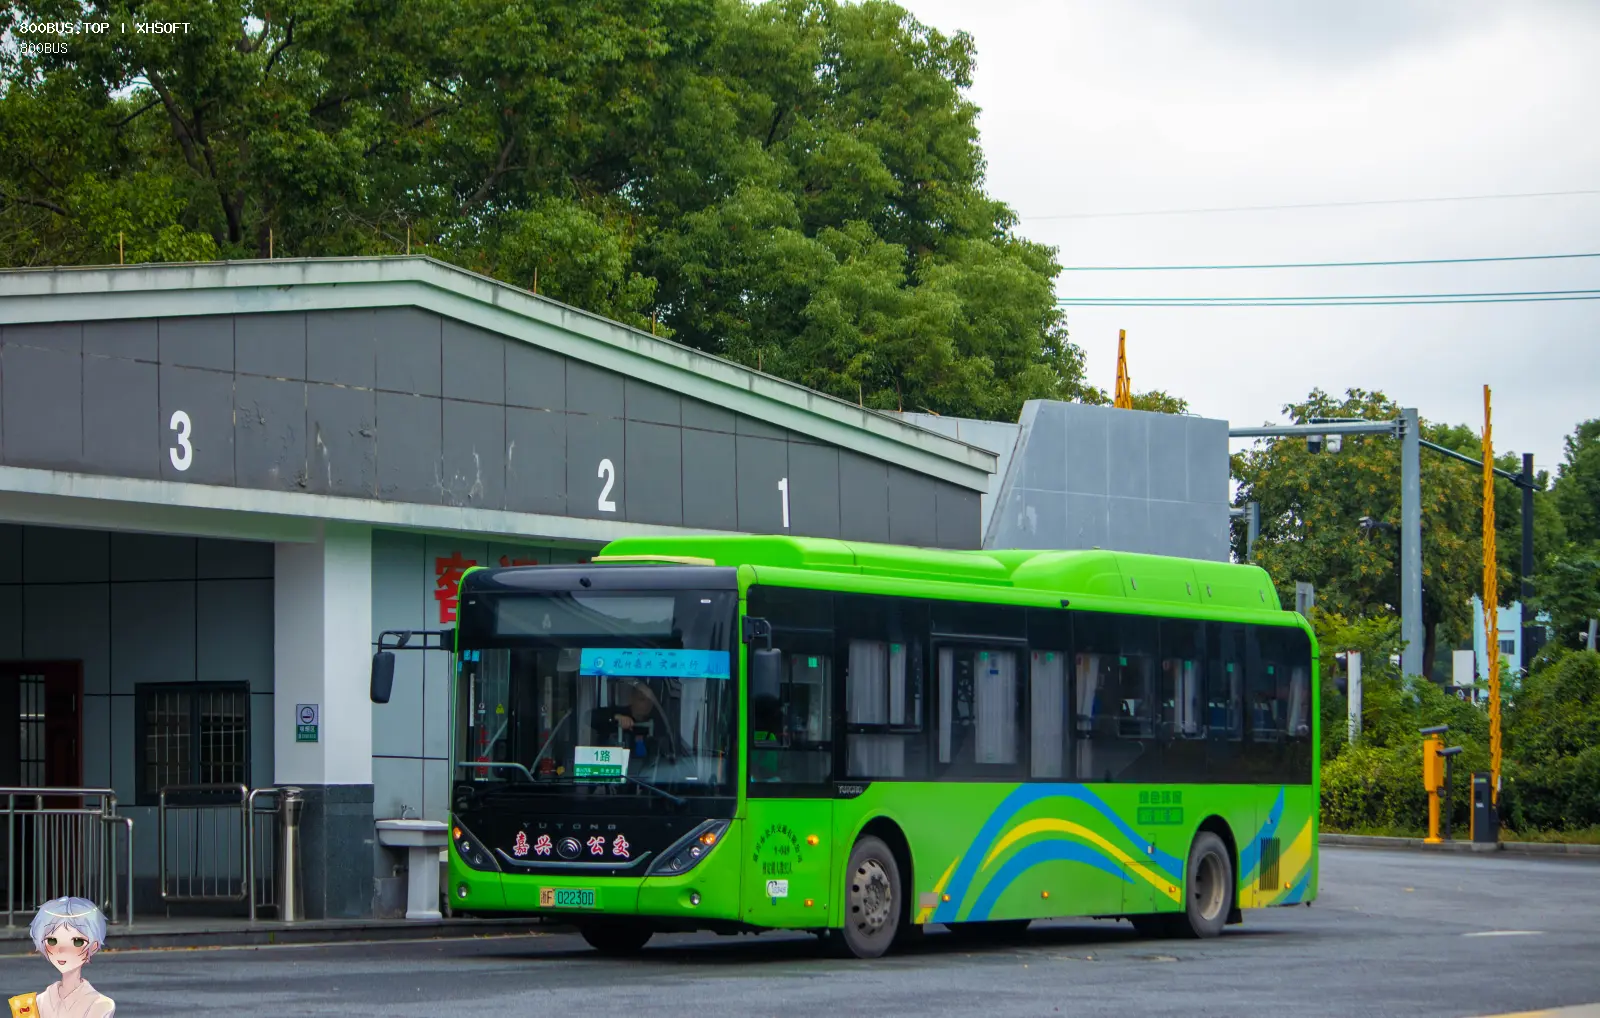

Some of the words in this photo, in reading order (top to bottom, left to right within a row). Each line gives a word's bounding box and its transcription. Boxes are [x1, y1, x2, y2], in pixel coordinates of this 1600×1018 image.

[169, 409, 193, 472] 3
[597, 457, 616, 513] 2
[778, 476, 791, 528] 1
[593, 750, 611, 763] 1路
[513, 831, 552, 856] 嘉兴
[587, 835, 629, 858] 公交
